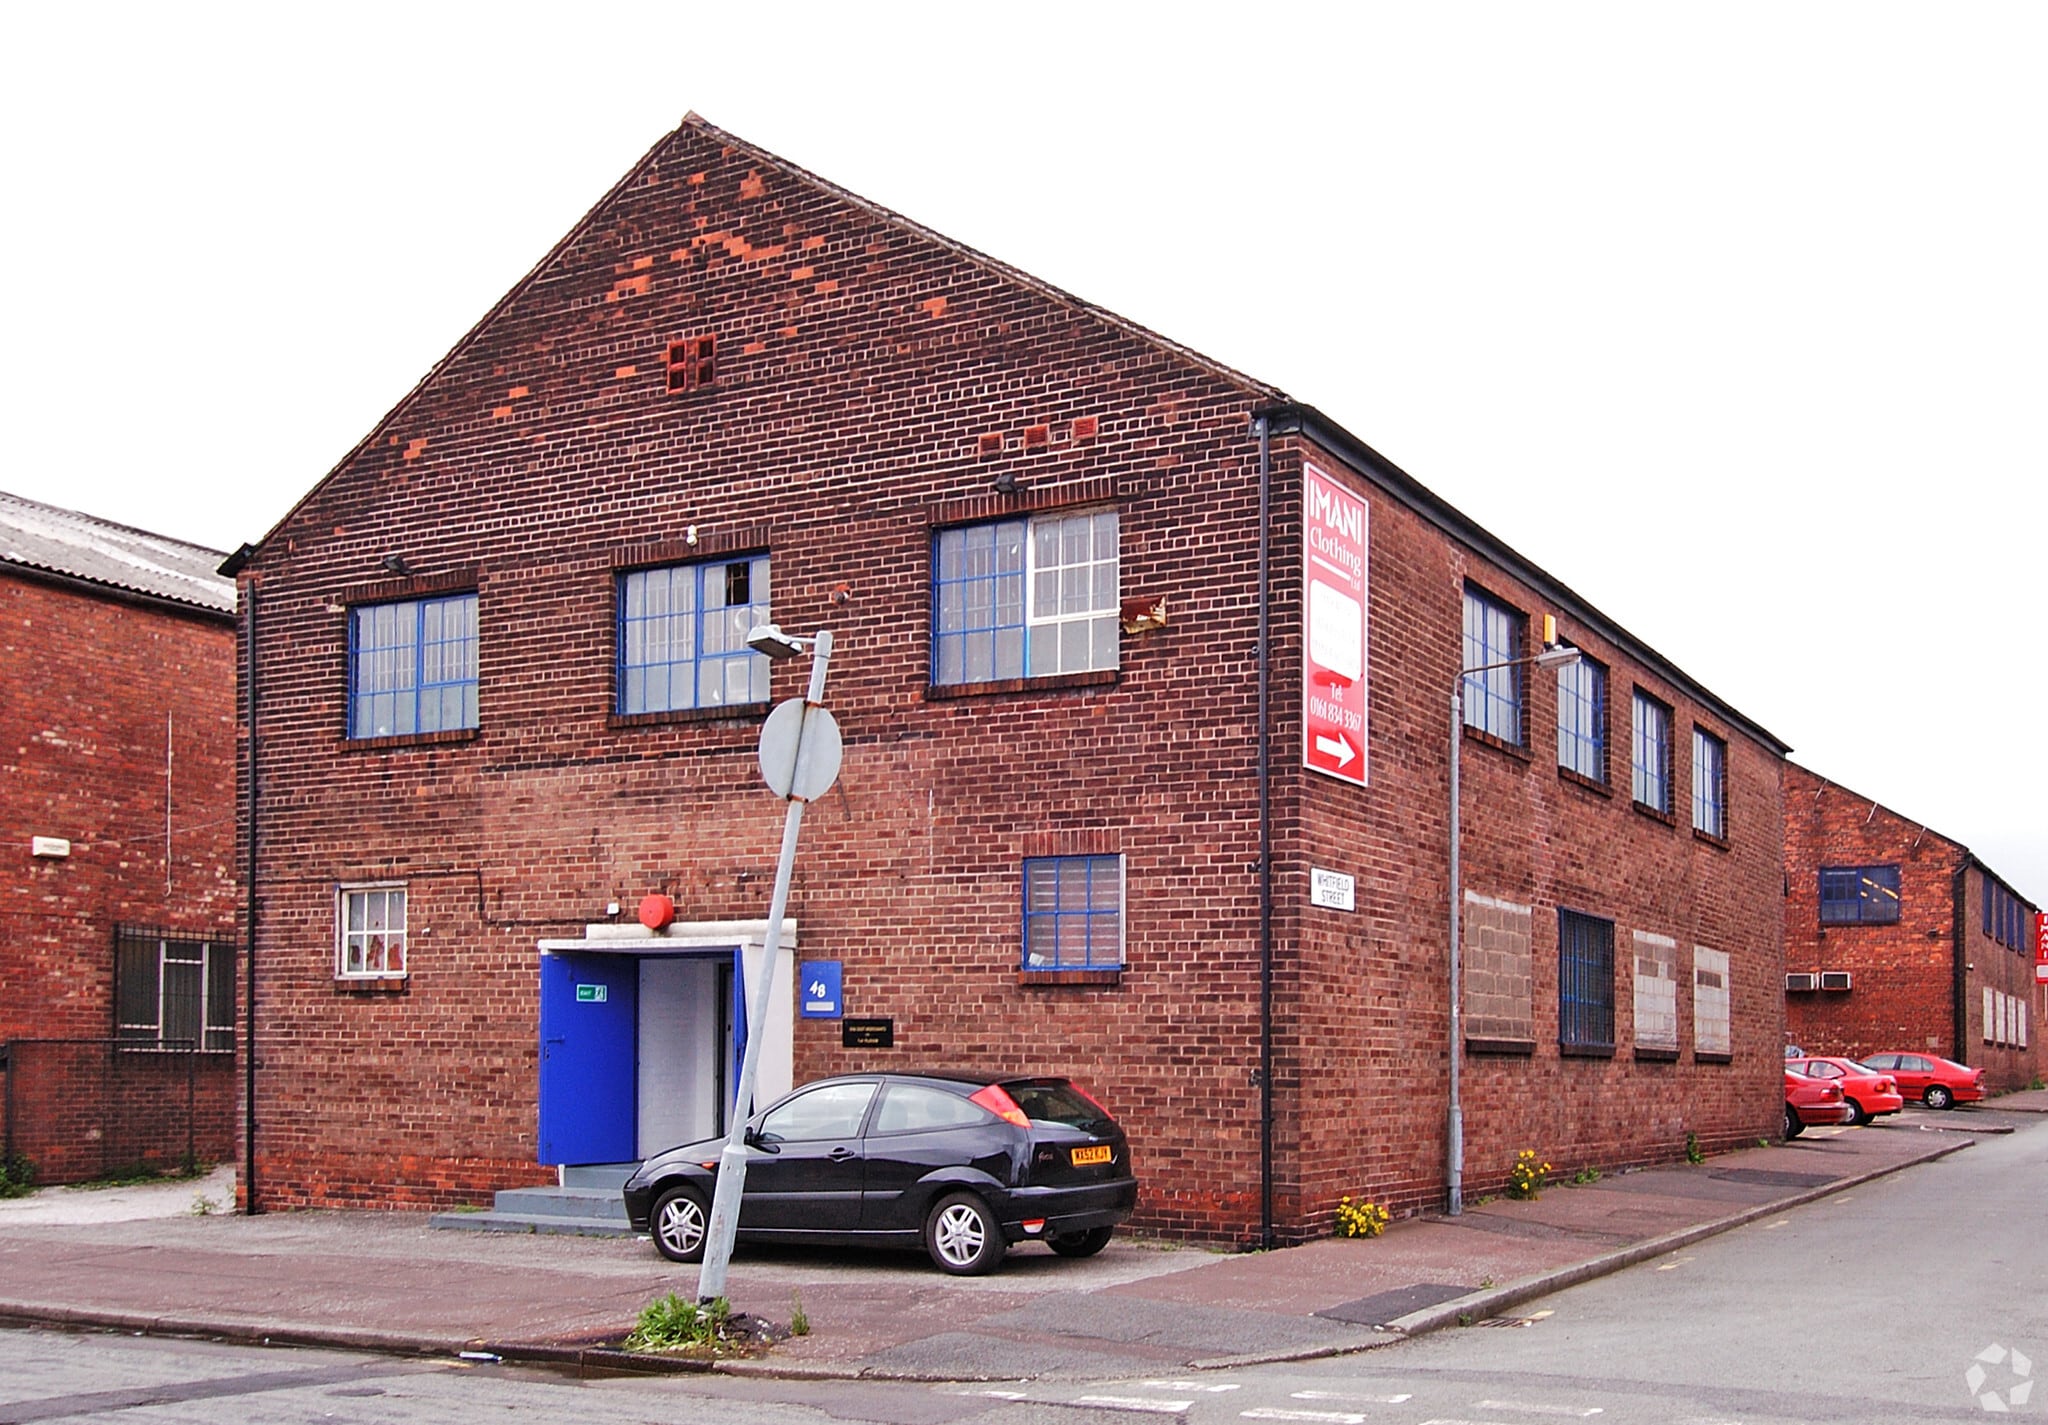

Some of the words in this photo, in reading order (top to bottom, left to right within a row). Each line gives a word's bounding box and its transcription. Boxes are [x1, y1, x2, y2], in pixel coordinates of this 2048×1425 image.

[1310, 480, 1361, 545] IMANI
[1310, 526, 1361, 577] Clothing
[1310, 696, 1327, 720] 0161
[1328, 703, 1343, 726] 834
[1344, 710, 1361, 732] 3367
[1317, 873, 1350, 891] WHITFIELD
[1321, 889, 1345, 906] STREET
